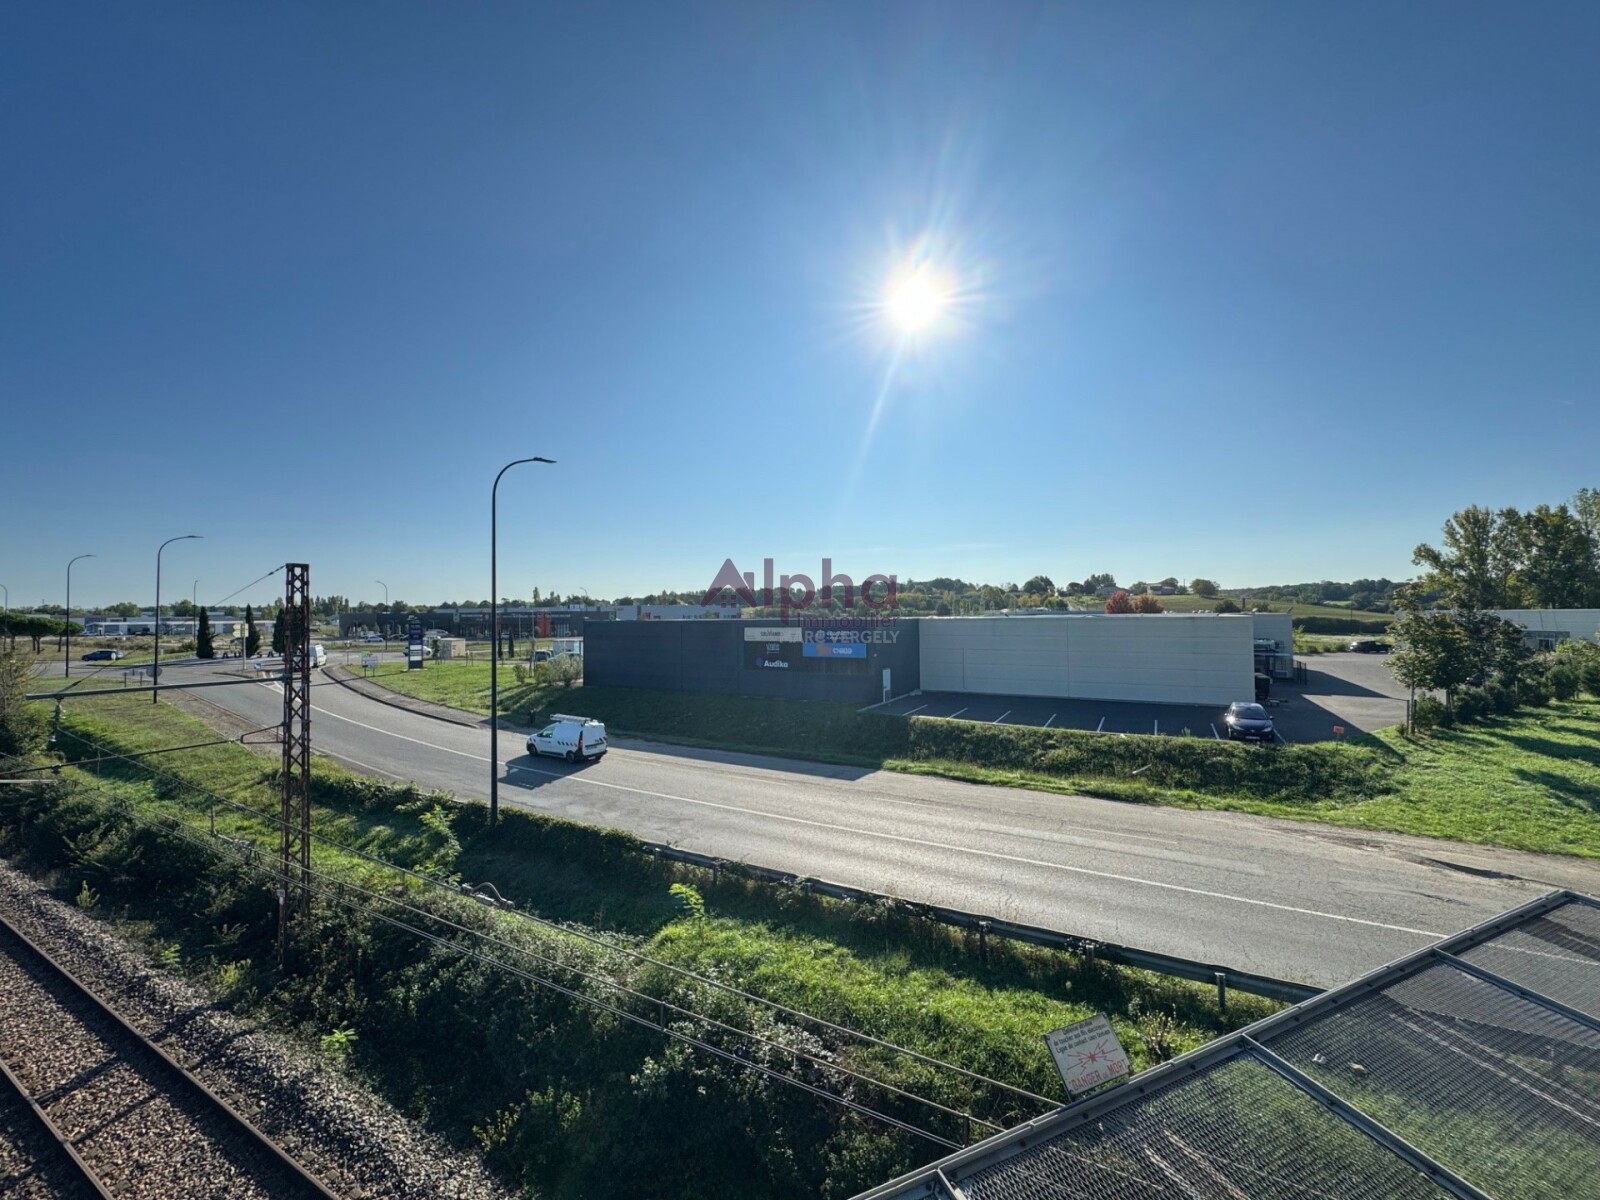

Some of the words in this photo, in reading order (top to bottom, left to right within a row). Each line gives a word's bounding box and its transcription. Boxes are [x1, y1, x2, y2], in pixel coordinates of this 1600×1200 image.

[764, 660, 788, 668] Audika
[1071, 1070, 1102, 1091] DANGER
[1106, 1059, 1127, 1075] MORT
